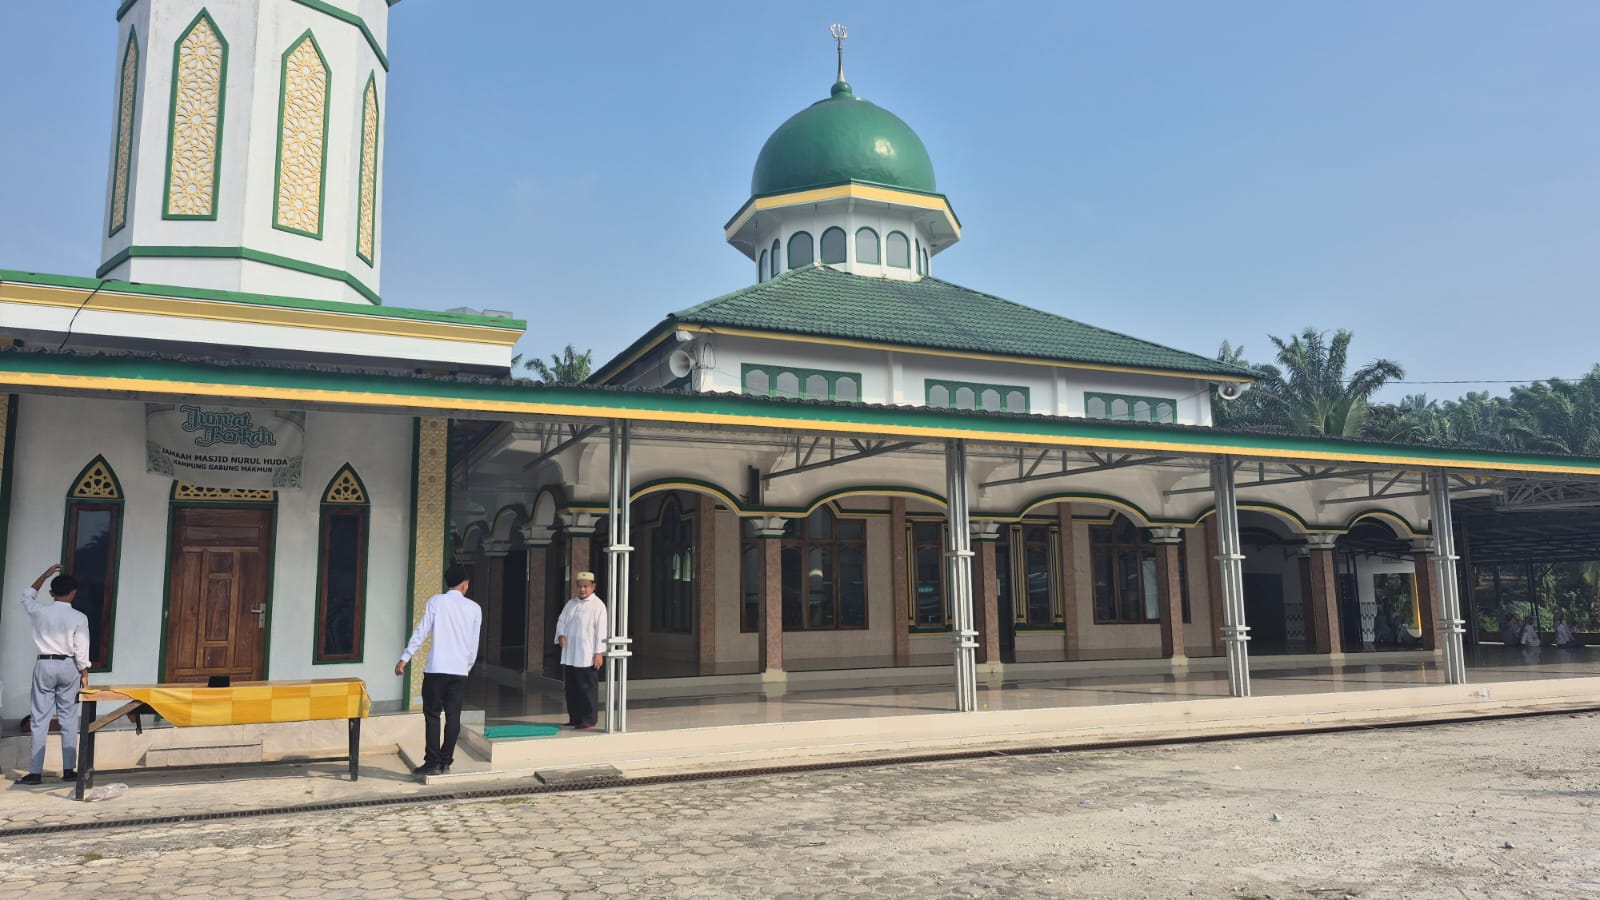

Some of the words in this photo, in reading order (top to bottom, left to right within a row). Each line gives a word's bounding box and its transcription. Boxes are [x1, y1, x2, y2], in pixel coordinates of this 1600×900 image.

[195, 424, 276, 448] Berkah
[162, 448, 192, 460] JAMAAH
[194, 455, 229, 464] MASJID
[231, 457, 261, 465] NURUL
[263, 458, 289, 466] HUDA
[173, 459, 207, 470] KAMPUNG
[208, 464, 239, 472] GABUNG
